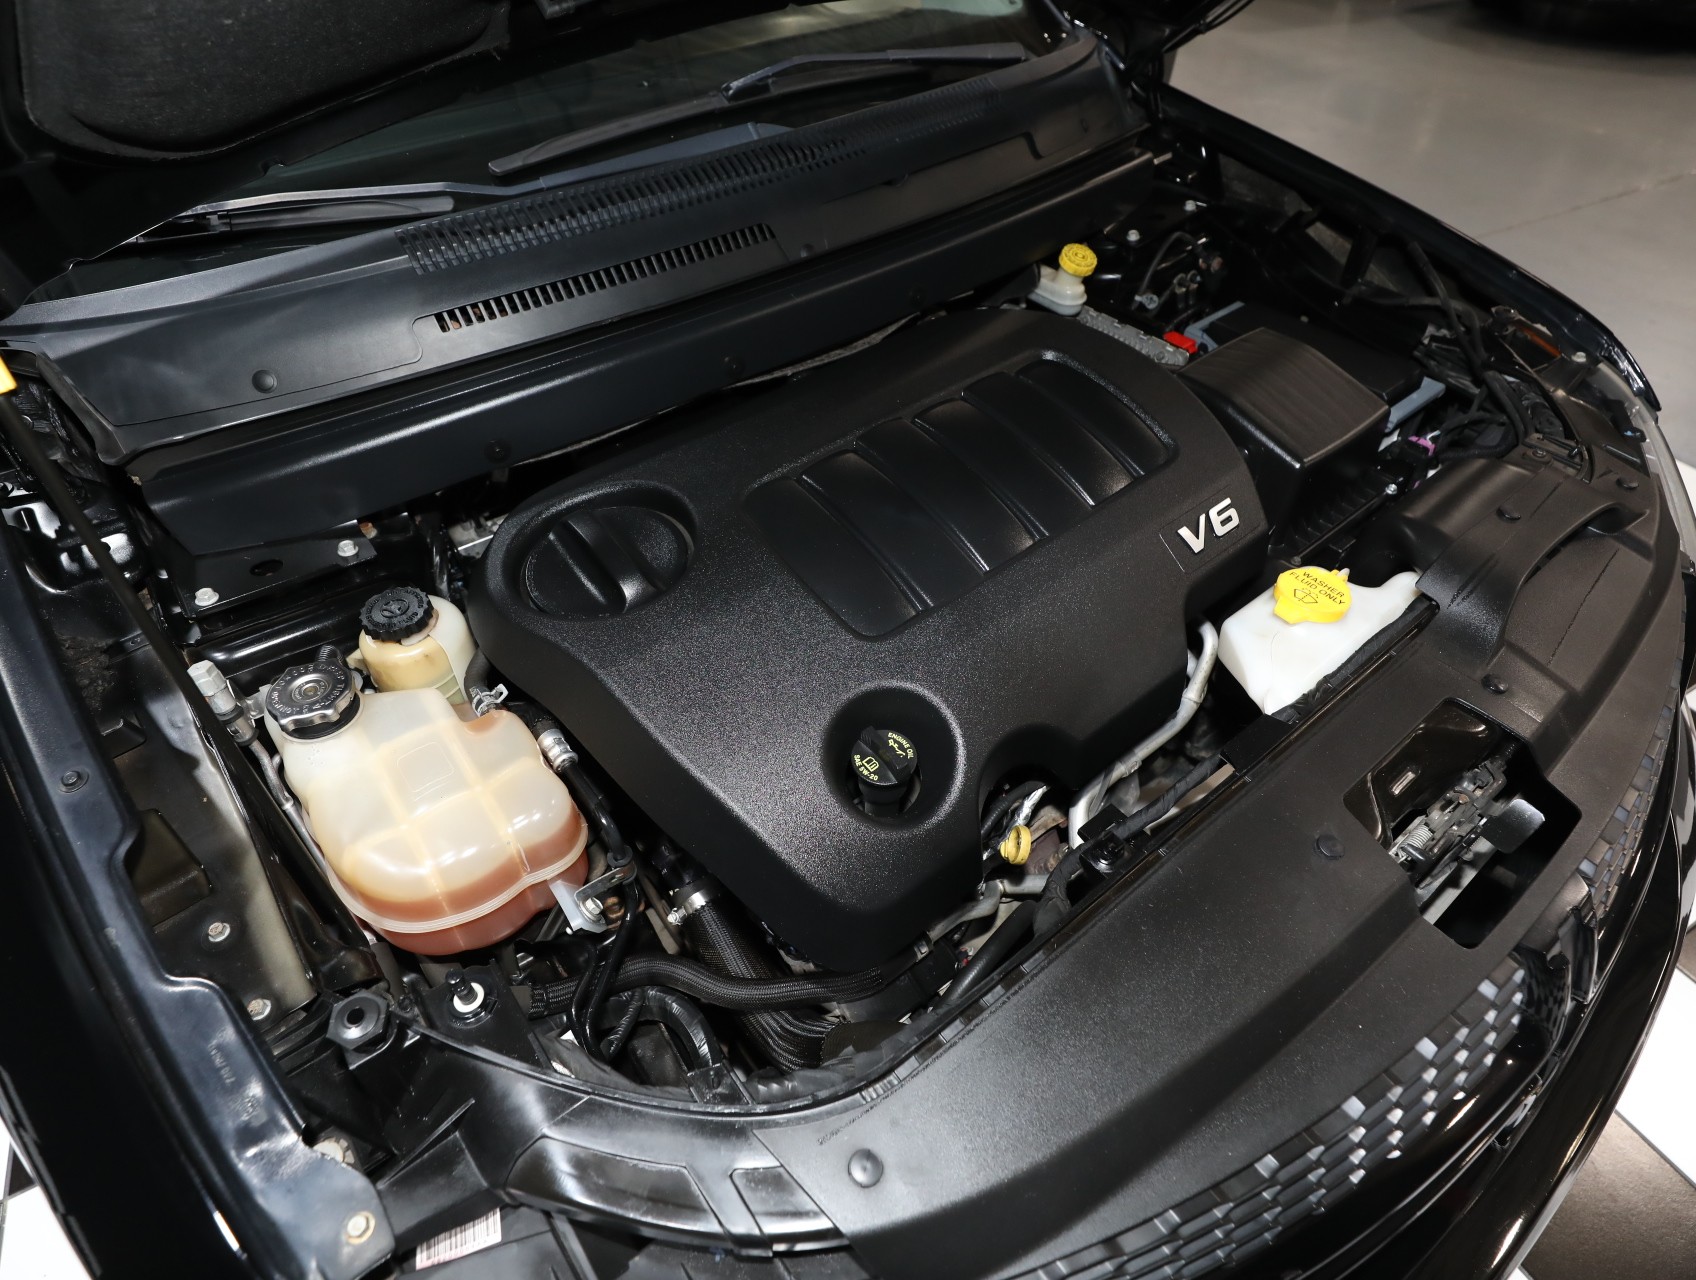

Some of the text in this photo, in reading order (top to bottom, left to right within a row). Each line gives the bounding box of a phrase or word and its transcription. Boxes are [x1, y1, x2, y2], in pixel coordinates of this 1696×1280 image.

[1177, 497, 1240, 554] V6
[1290, 571, 1345, 605] FLUID ONLY
[1302, 571, 1344, 598] WASHER
[888, 732, 914, 759] ENGINE OIL
[853, 754, 879, 781] SAE 5W-20
